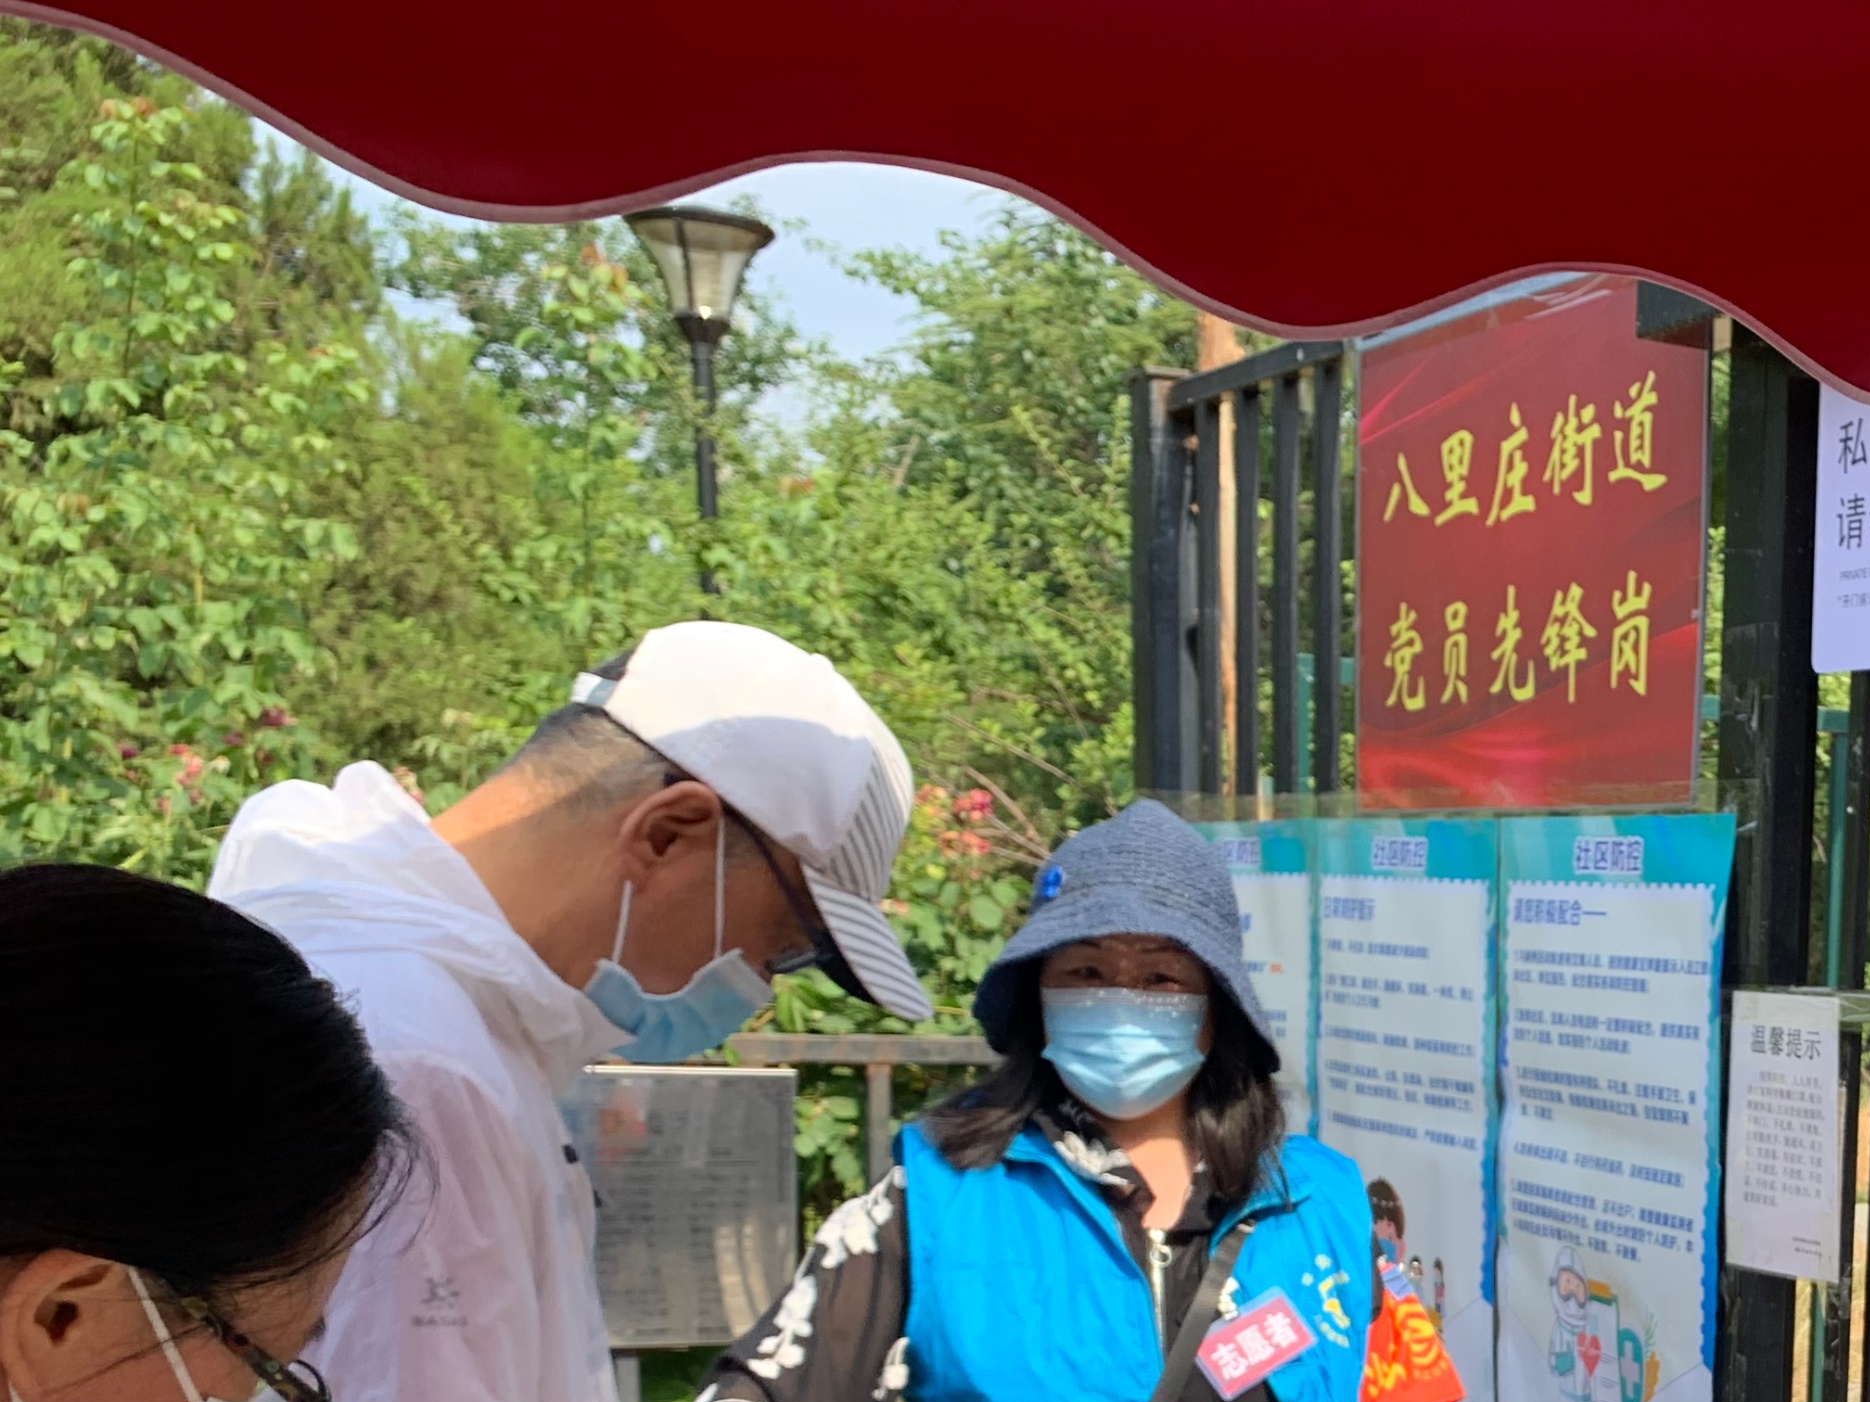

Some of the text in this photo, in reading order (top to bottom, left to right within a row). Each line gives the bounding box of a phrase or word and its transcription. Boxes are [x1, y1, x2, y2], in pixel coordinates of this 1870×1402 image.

[1383, 369, 1668, 527] 八里庄街道
[1384, 569, 1653, 712] 党员先锋岗
[1574, 839, 1642, 872] 社区防控
[1751, 1024, 1822, 1060] 温馨提示
[1210, 1310, 1299, 1380] 志愿者
